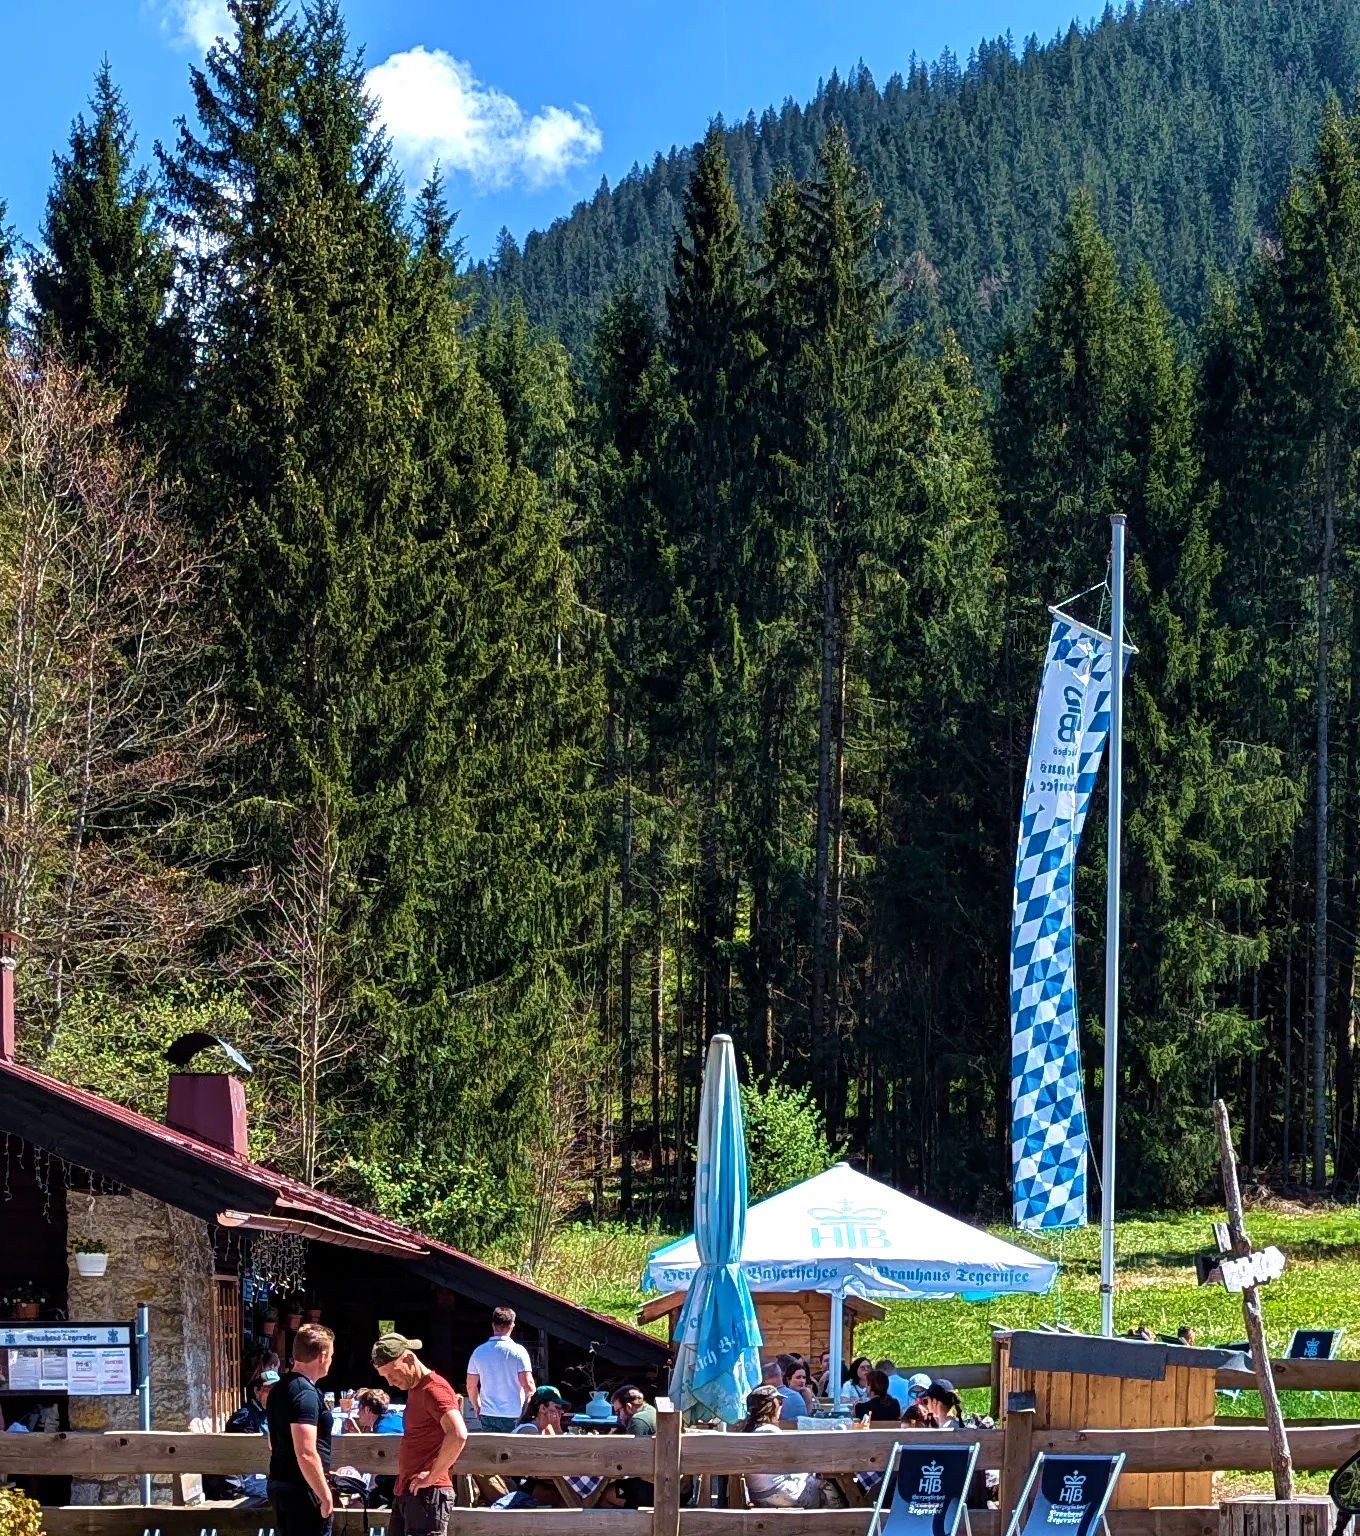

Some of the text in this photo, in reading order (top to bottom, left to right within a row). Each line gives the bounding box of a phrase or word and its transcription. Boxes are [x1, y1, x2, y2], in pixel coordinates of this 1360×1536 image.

[811, 1222, 891, 1250] HTB
[876, 1265, 951, 1285] Brauhaus
[955, 1268, 1030, 1286] Tegernsee
[918, 1475, 942, 1494] HTB
[1059, 1485, 1083, 1504] HTB
